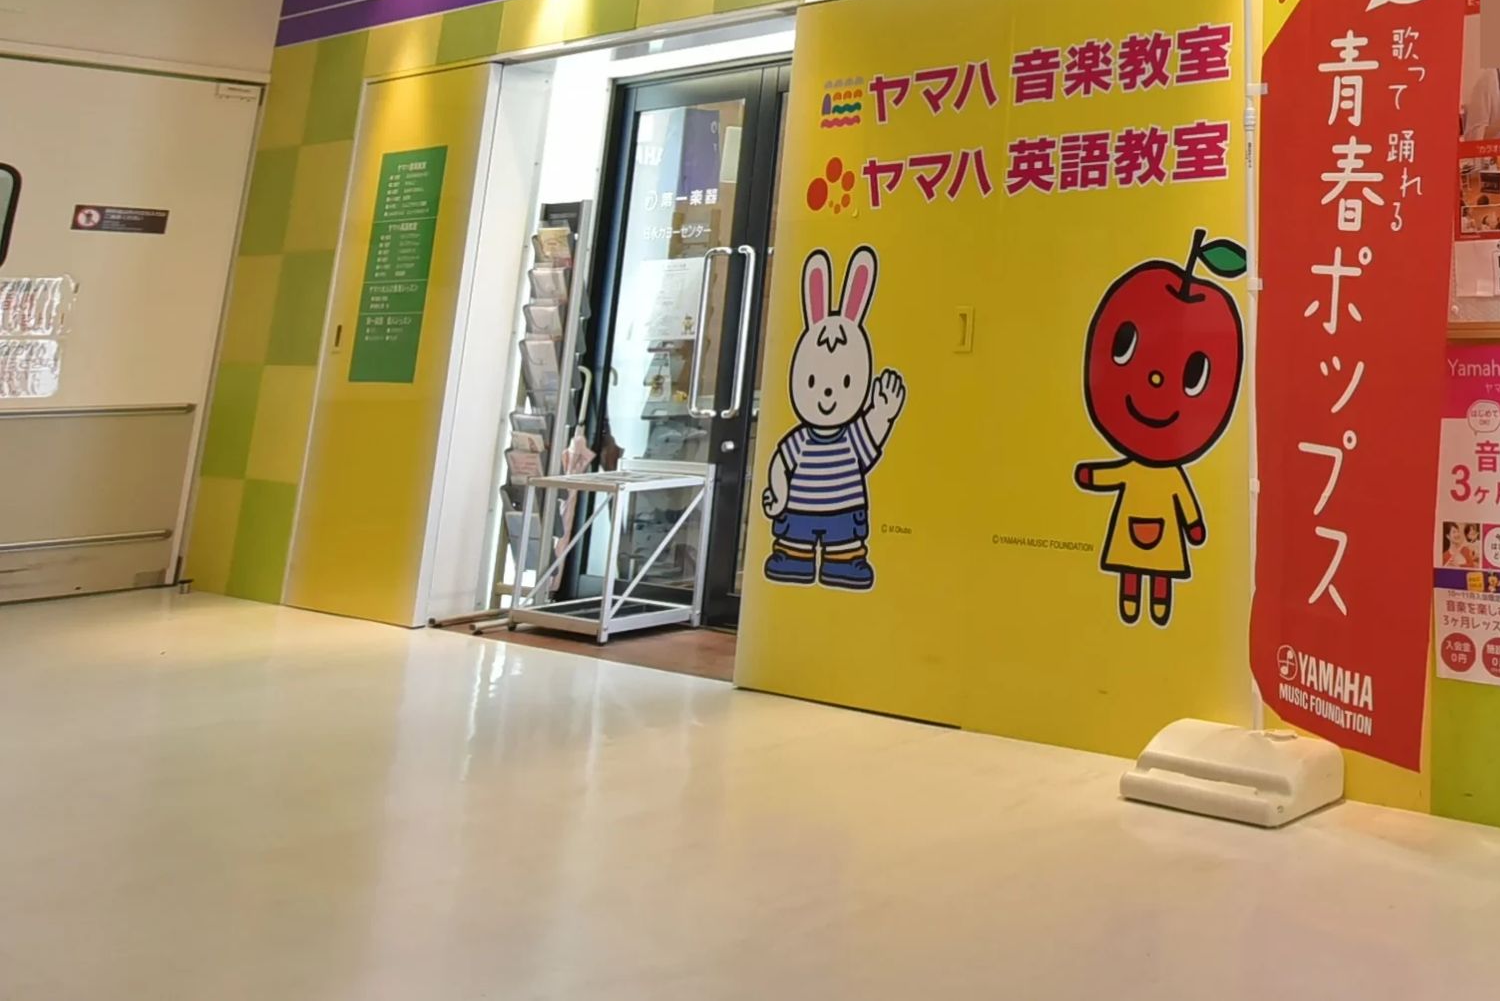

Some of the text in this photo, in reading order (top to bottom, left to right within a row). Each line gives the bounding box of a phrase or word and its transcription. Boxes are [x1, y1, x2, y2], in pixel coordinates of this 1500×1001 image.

[867, 23, 1232, 125] ヤマハ 音楽教室
[861, 121, 1230, 210] ヤマハ 英語教室
[1387, 26, 1426, 232] 歌って 踊れる
[1298, 30, 1385, 616] 青春ポップス
[1298, 651, 1373, 711] YAMAHA
[1451, 654, 1467, 663] 0円
[1279, 683, 1372, 736] MUSIC FOUNDATION
